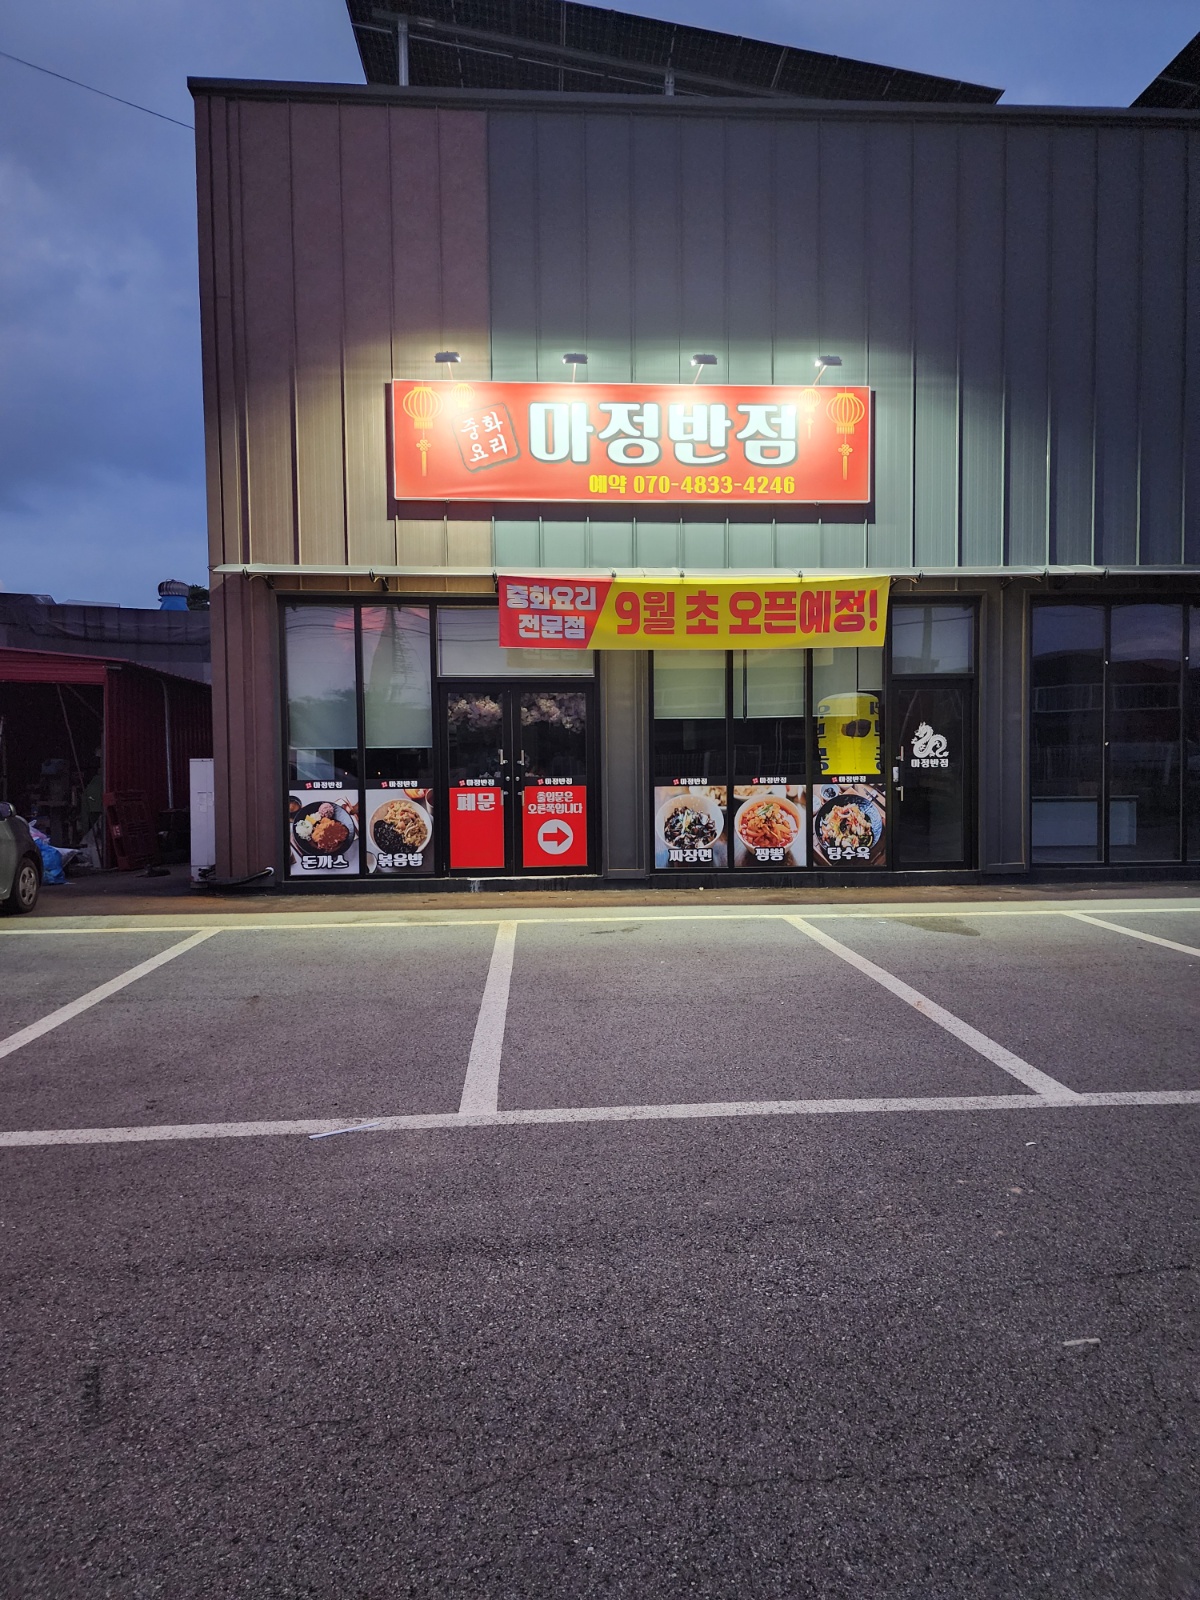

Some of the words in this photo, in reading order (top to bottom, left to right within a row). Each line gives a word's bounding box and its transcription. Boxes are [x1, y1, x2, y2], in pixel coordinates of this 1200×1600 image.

[460, 411, 503, 440] 중화
[529, 402, 798, 465] 마정반점
[470, 434, 507, 462] 요리
[589, 475, 627, 493] 예약
[633, 475, 796, 494] 070-4833-4246
[506, 584, 597, 611] 중화요리
[614, 591, 676, 636] 9월
[685, 590, 719, 635] 초
[728, 589, 879, 635] 오픈예정!
[518, 614, 587, 640] 전문점
[910, 758, 949, 768] 마정반점
[388, 780, 418, 788] 마정반점
[466, 778, 495, 786] 마정반점
[545, 777, 573, 785] 마정반점
[759, 776, 787, 784] 마정반점
[838, 775, 867, 783] 마정반점
[456, 792, 496, 811] 폐문
[536, 791, 574, 803] 출입문은
[527, 803, 583, 815] 오른쪽입니다
[377, 853, 424, 868] 볶음밥
[668, 847, 713, 863] 짜장면
[754, 846, 785, 861] 짬뽕
[827, 846, 871, 861] 탕수육
[301, 855, 349, 870] 돈까스
